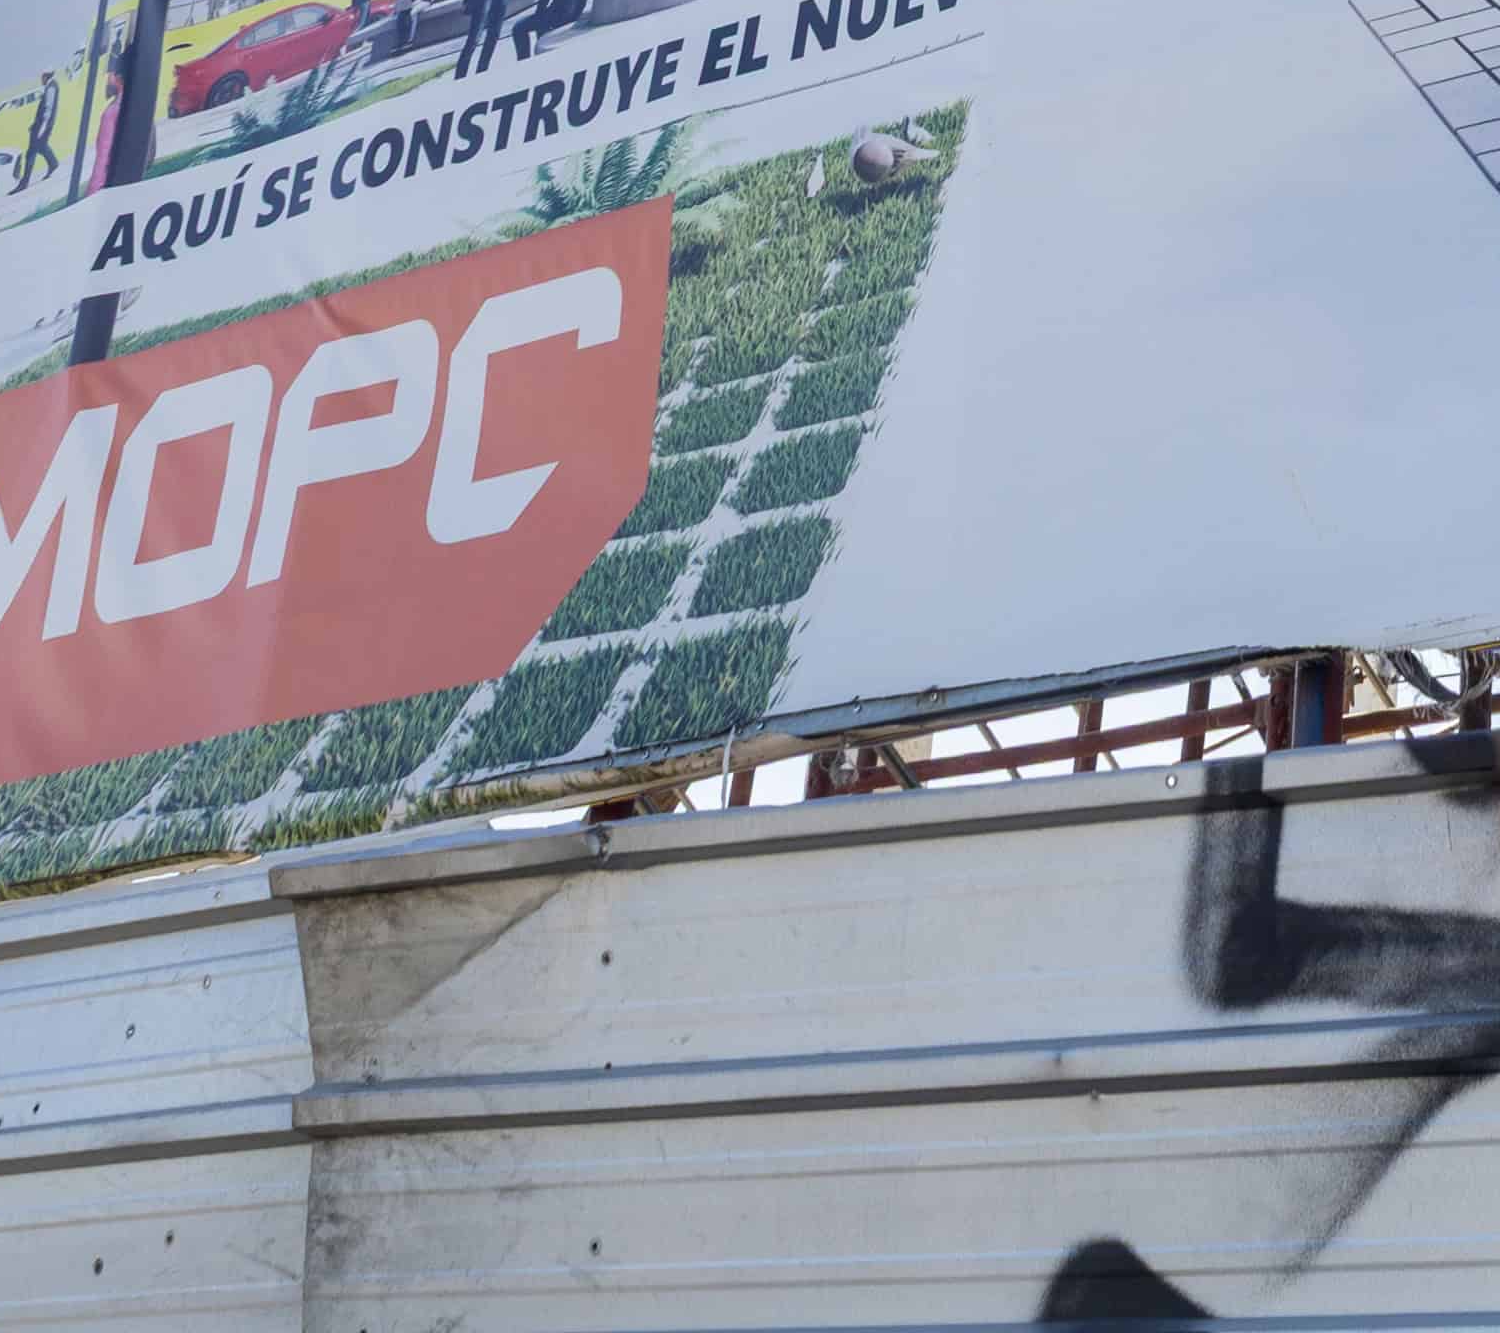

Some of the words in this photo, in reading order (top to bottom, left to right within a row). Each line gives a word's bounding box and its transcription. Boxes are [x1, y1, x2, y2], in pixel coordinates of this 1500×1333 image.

[90, 163, 253, 271] AQUÍ
[255, 156, 319, 229] SE
[330, 37, 684, 201] CONSTRUYE
[698, 15, 768, 86] EL
